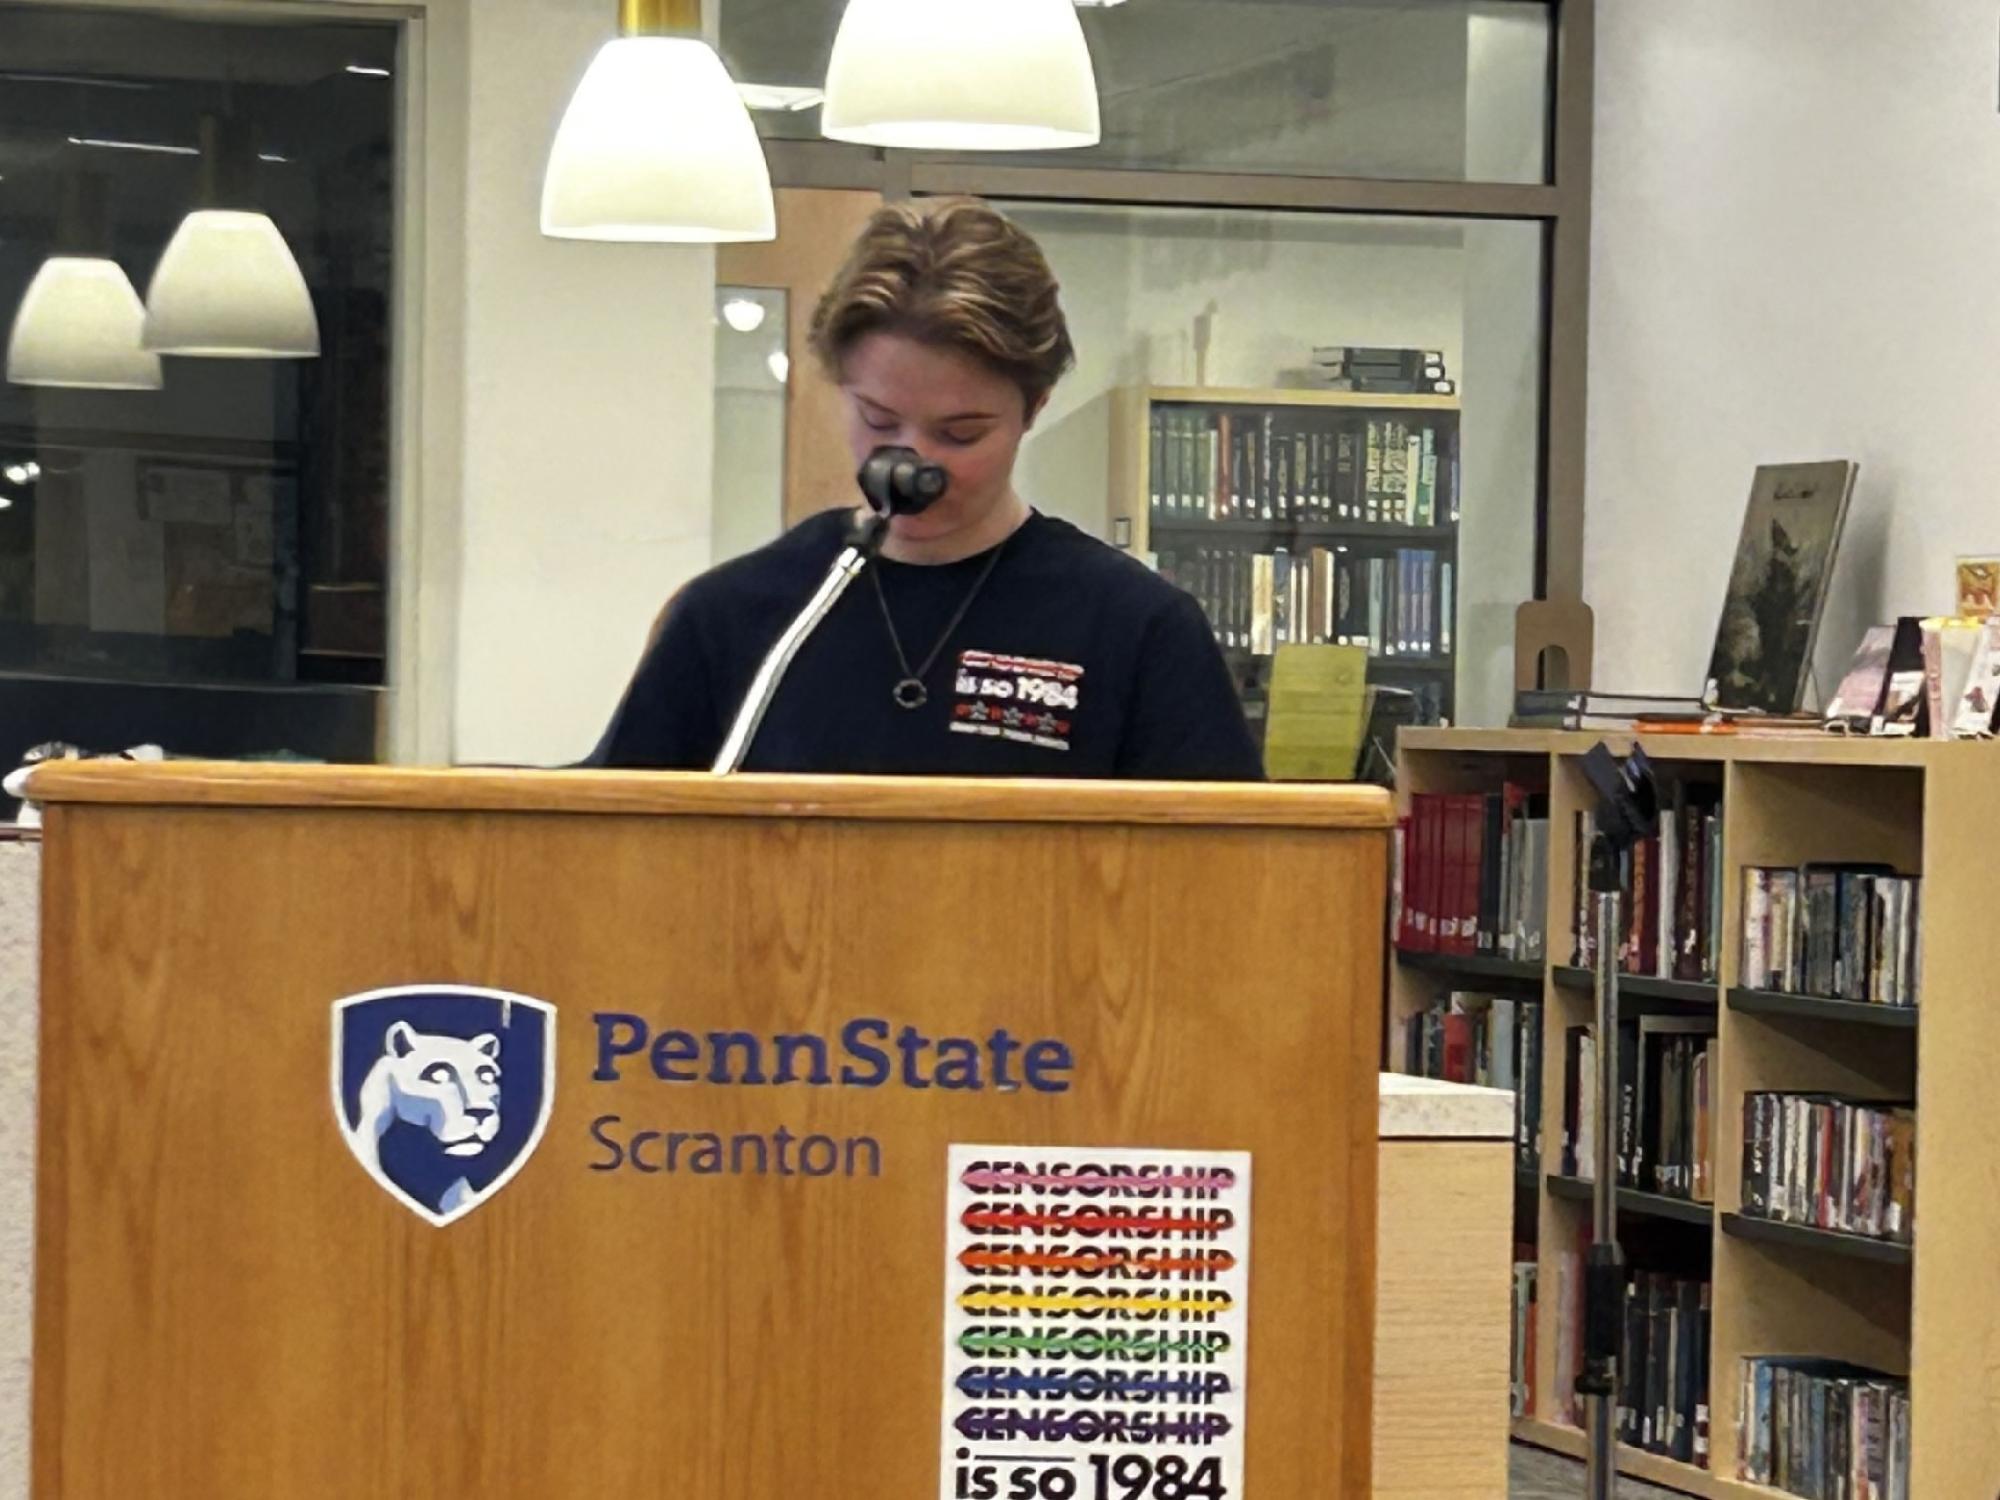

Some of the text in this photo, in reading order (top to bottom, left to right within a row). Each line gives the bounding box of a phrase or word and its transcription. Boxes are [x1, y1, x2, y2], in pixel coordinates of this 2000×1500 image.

[980, 678, 1014, 698] so
[1017, 676, 1079, 709] 1984
[592, 1013, 1073, 1092] PennState
[588, 1115, 880, 1178] Scranton
[963, 1161, 1235, 1199] CENSORSHIP
[962, 1202, 1234, 1240] CENSORSHIP
[960, 1243, 1235, 1281] CENSORSHIP
[959, 1284, 1232, 1322] CENSORSHIP
[959, 1325, 1230, 1363] CENSORSHIP
[957, 1366, 1230, 1404] CENSORSHIP
[955, 1407, 1230, 1445] CENSORSHIP
[955, 1447, 1227, 1500] is so 1984
